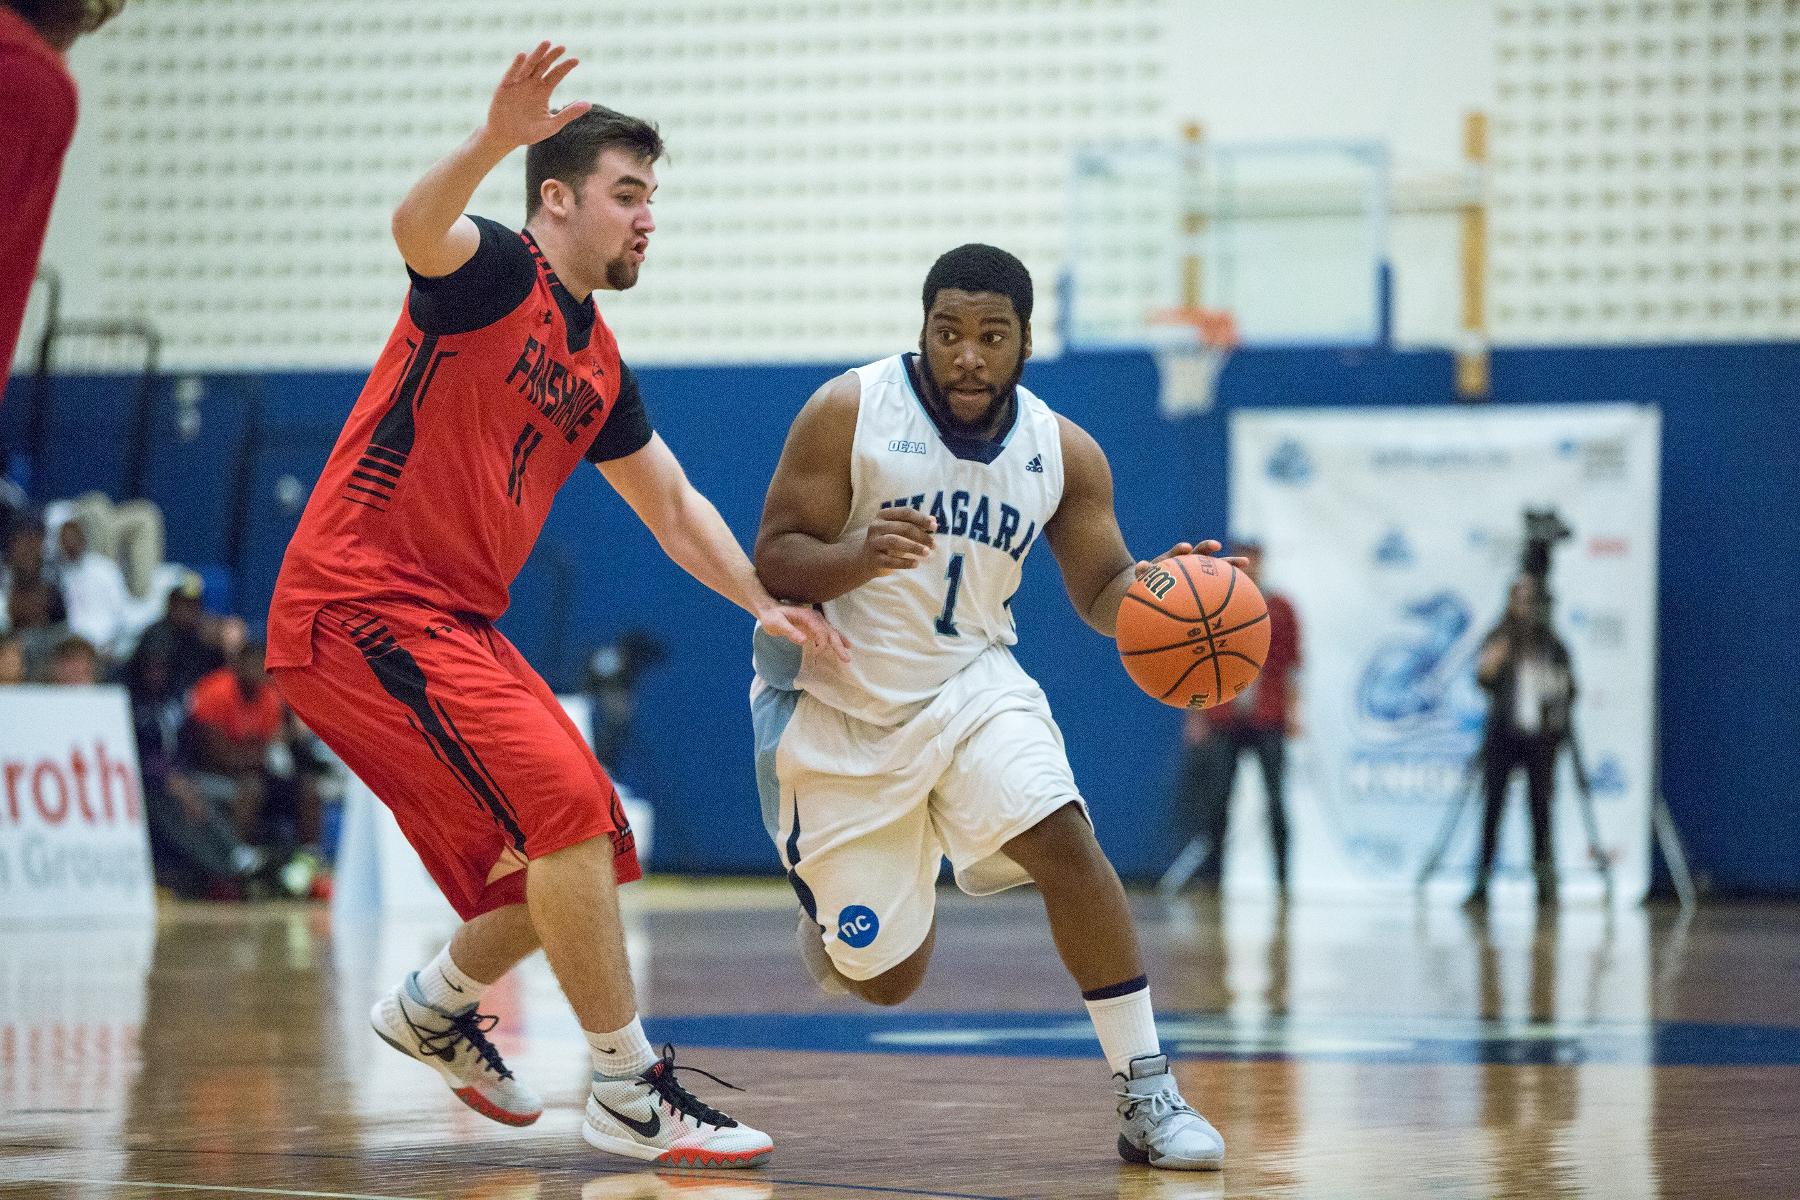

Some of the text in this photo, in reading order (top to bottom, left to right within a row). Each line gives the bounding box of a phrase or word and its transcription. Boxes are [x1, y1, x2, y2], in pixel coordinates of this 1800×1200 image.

[506, 422, 543, 507] 11
[888, 440, 926, 455] OCAA
[880, 489, 1036, 562] AGAR
[935, 552, 965, 637] 1
